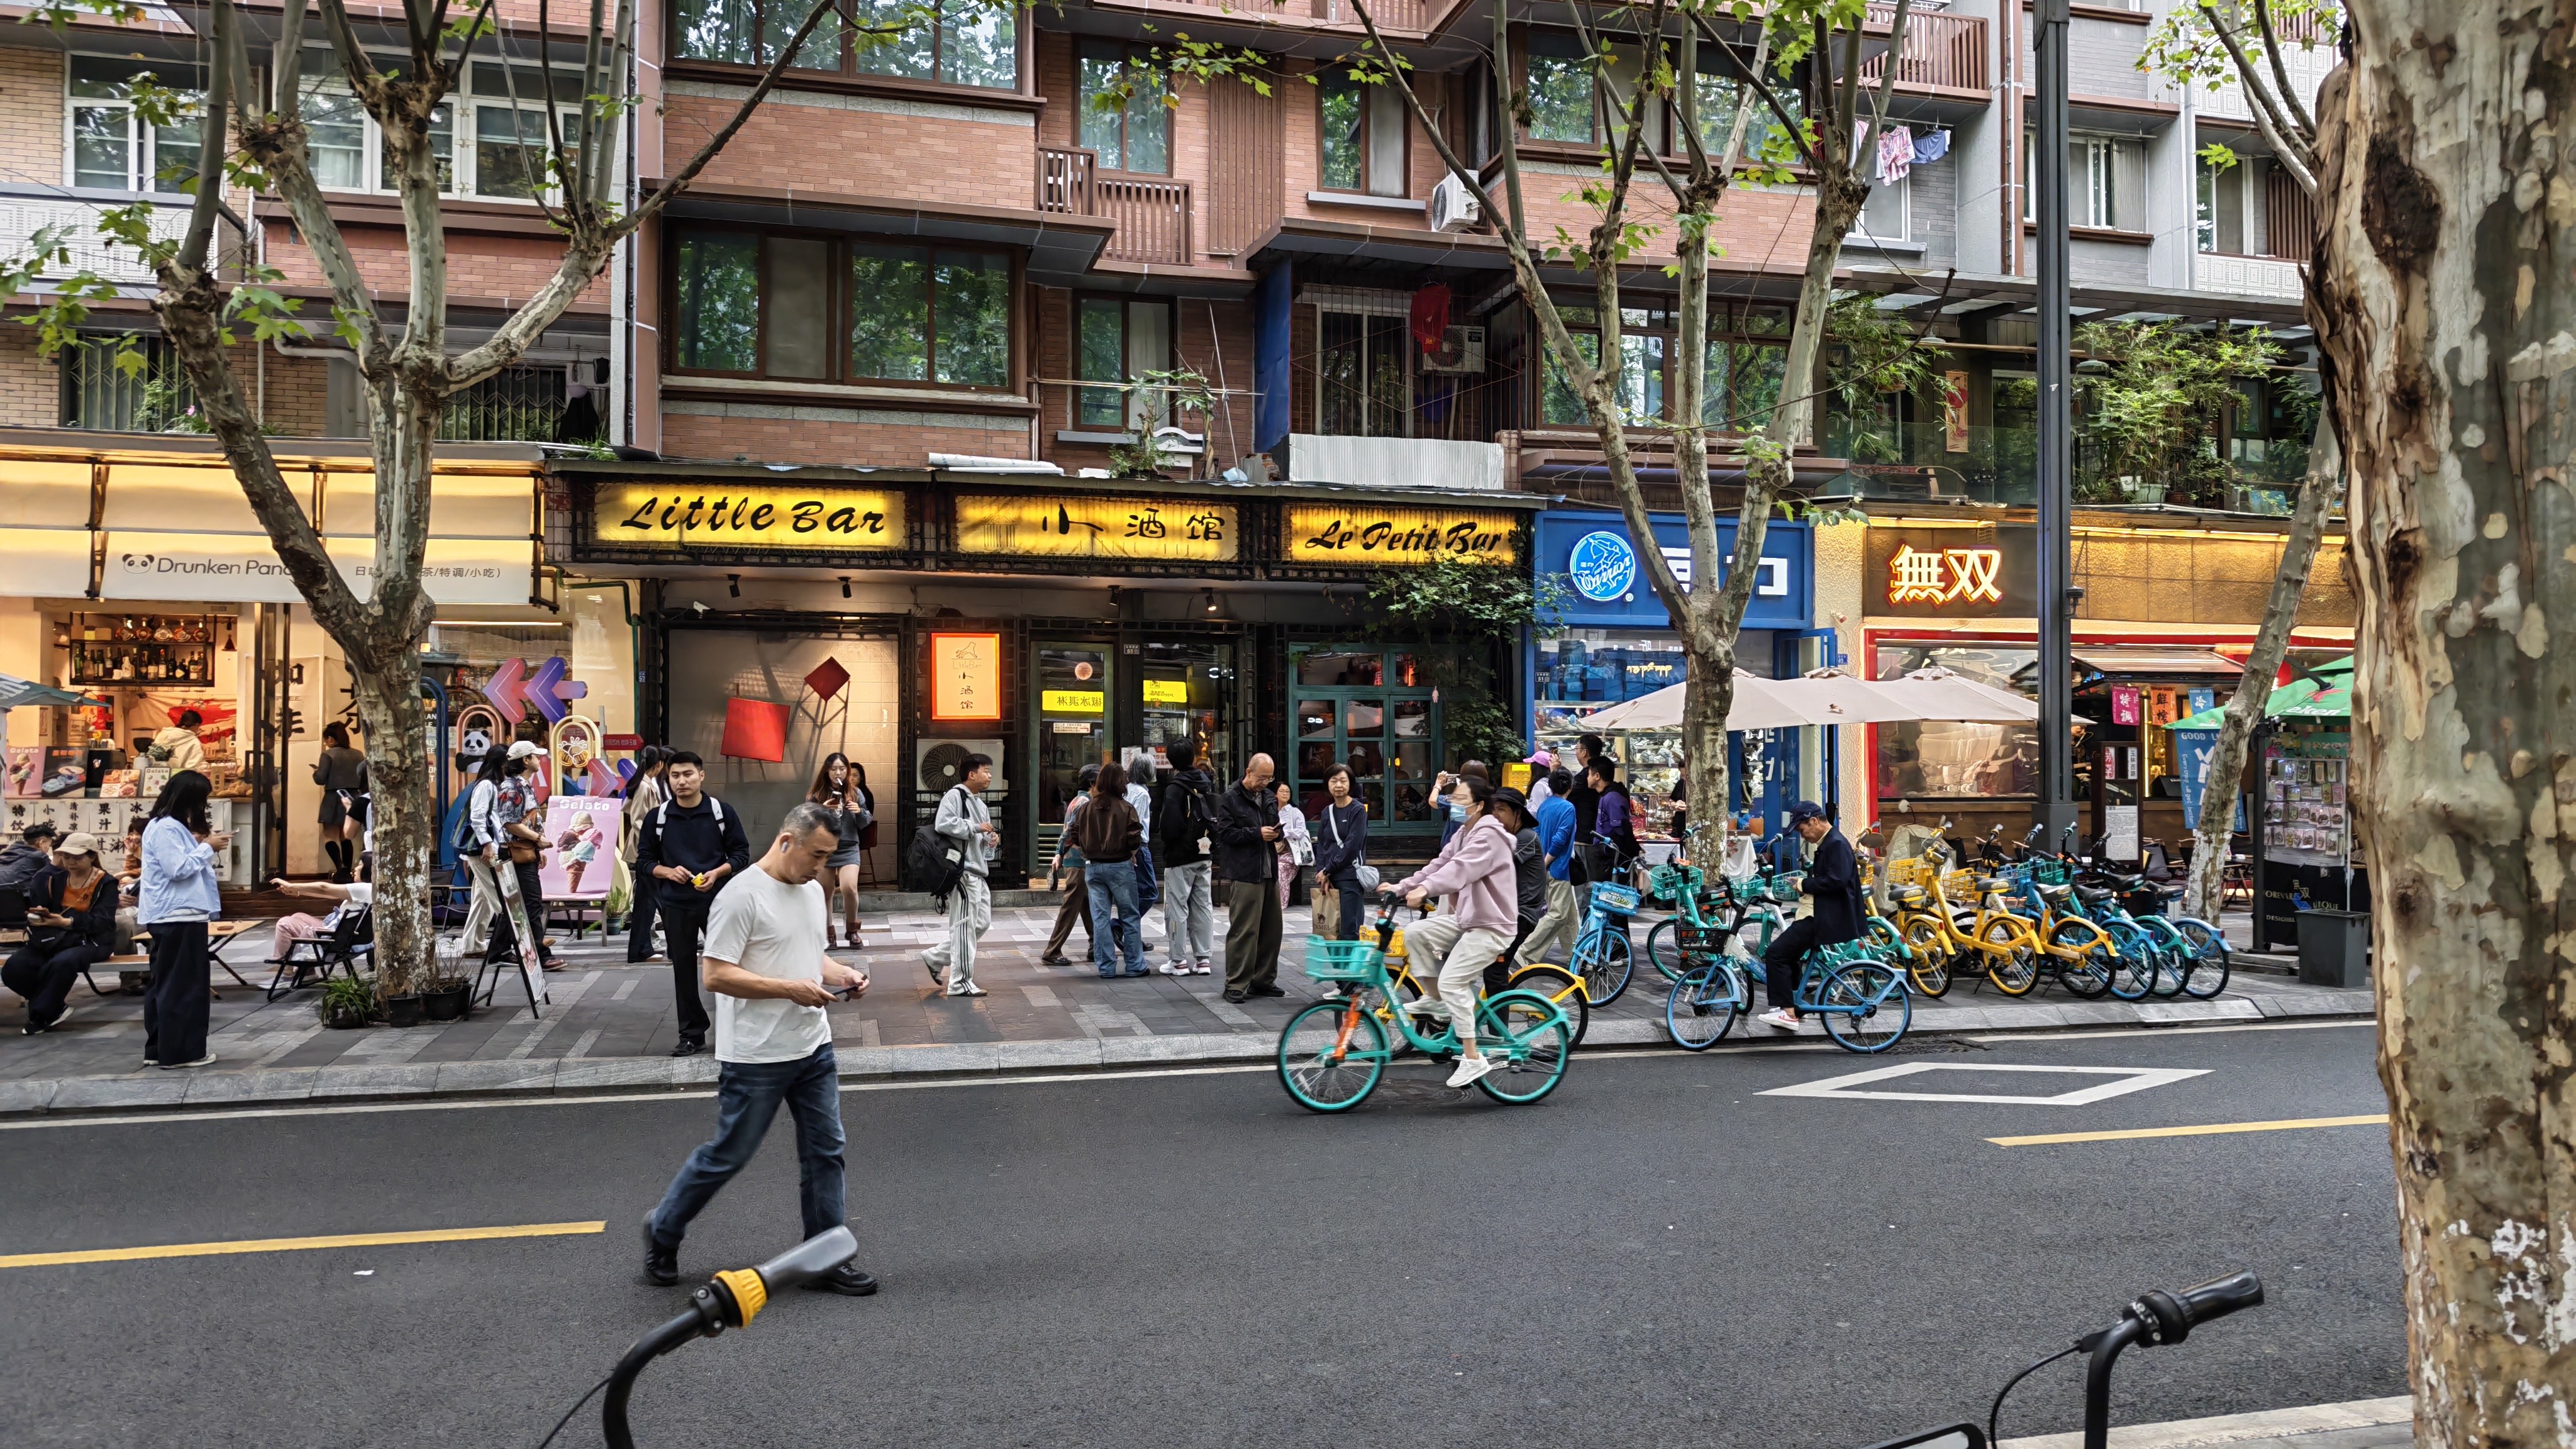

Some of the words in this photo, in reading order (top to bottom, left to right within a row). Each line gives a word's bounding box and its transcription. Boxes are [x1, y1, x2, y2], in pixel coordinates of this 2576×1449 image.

[619, 495, 775, 531] Little
[791, 501, 884, 534] Bar
[1041, 503, 1225, 541] 小酒馆
[1304, 520, 1354, 550] Le
[1362, 521, 1440, 552] Petit
[1445, 521, 1503, 555] Bar
[157, 557, 240, 574] Drunken
[1577, 555, 1631, 591] Warrior
[1889, 544, 2002, 603] 無双
[958, 670, 974, 709] 小酒馆
[2180, 732, 2206, 741] GOOD
[10, 804, 26, 831] 特饮
[98, 802, 112, 831] 果汁
[559, 798, 610, 811] Gelato
